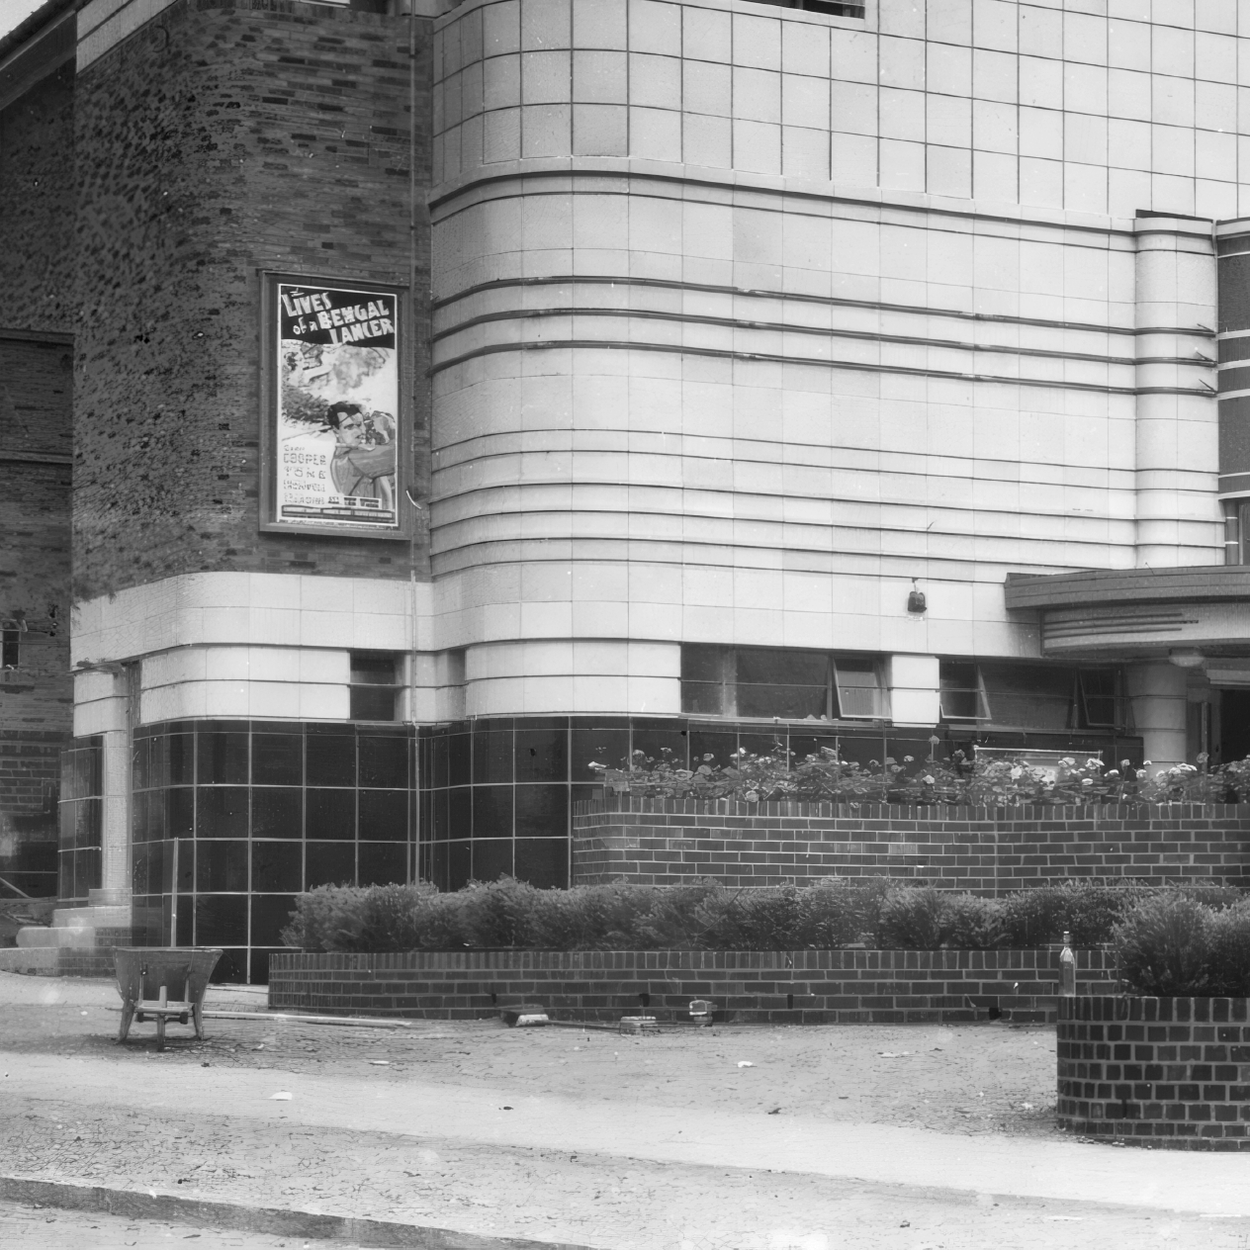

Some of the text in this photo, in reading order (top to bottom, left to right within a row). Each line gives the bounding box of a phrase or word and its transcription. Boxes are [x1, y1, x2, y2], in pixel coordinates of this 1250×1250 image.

[281, 292, 332, 317] LIVES
[317, 299, 390, 329] BENGAL
[329, 318, 395, 344] LANCER
